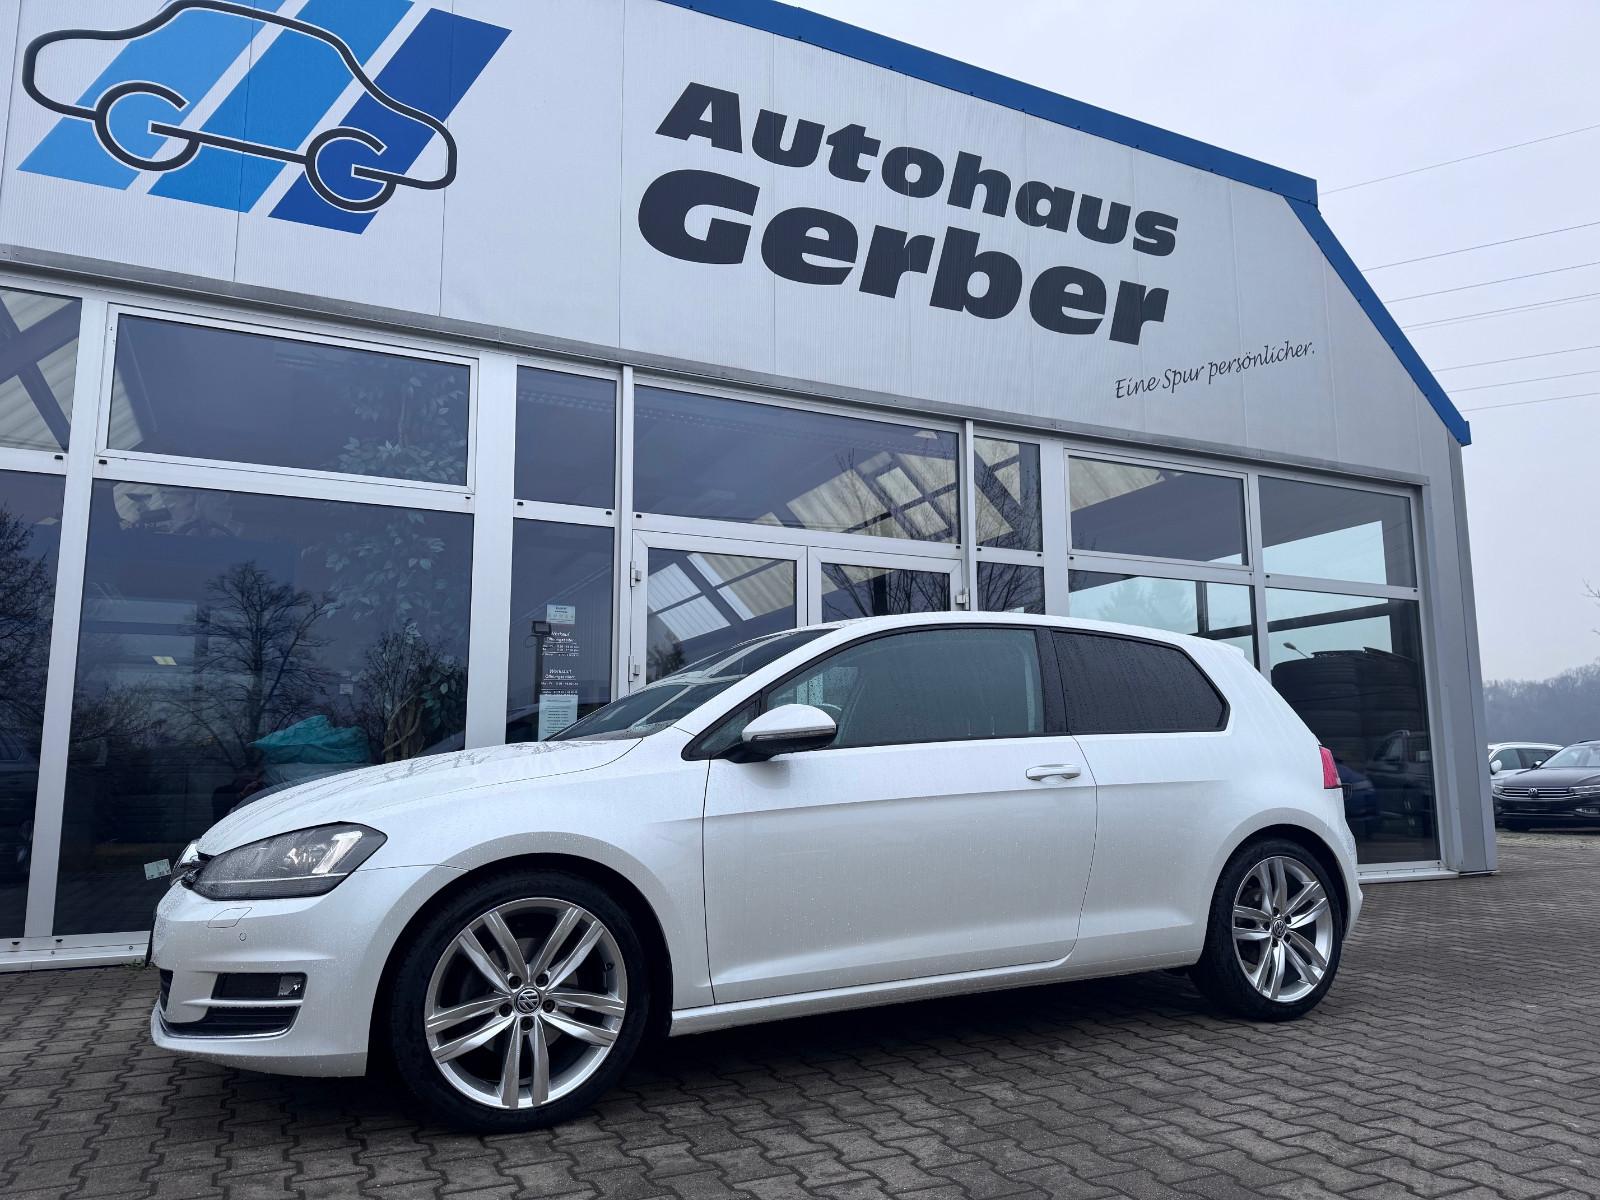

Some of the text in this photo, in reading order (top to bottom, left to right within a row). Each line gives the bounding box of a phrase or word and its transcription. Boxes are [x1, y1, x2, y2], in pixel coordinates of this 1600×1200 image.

[656, 82, 1178, 256] Autohaus
[638, 170, 1169, 345] Gerber
[1115, 340, 1315, 399] Eine Spur persönlicher.
